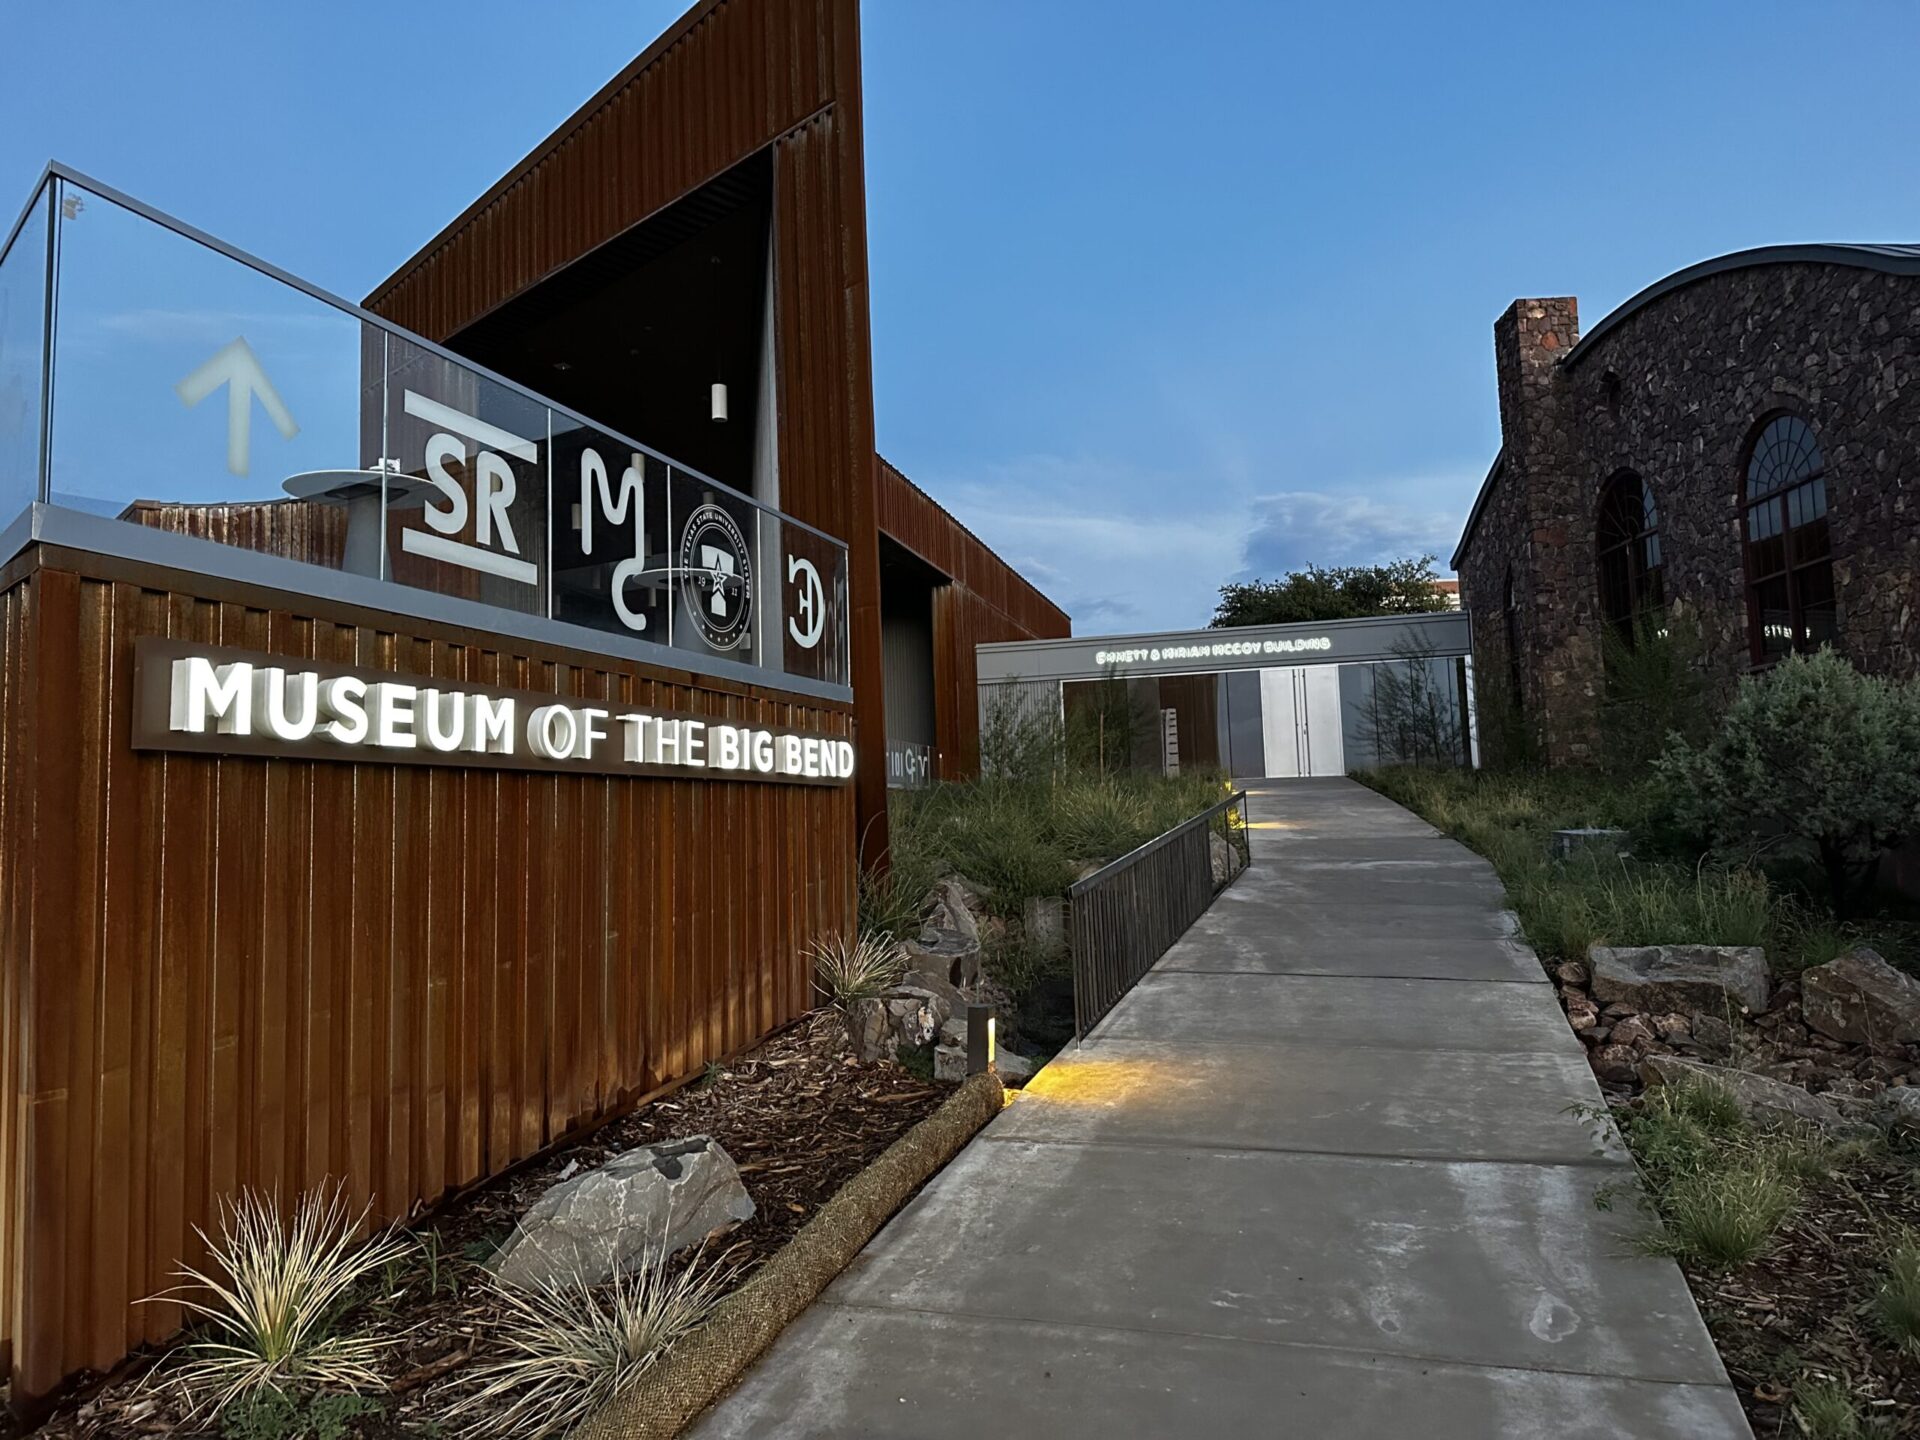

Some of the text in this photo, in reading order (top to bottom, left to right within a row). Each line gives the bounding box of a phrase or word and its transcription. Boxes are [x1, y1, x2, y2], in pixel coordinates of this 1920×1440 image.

[425, 433, 520, 554] SR
[685, 522, 697, 553] TEXAS
[696, 511, 713, 526] STATE
[715, 512, 744, 554] UNIVERSITY
[1162, 645, 1210, 660] MIRIAM
[1212, 641, 1261, 656] MCCOY
[1263, 637, 1331, 654] BUILDING
[170, 657, 515, 755] MUSEUM
[527, 704, 608, 759] OF
[616, 714, 705, 766] THE
[709, 725, 774, 773] BIG
[775, 734, 855, 778] BEND
